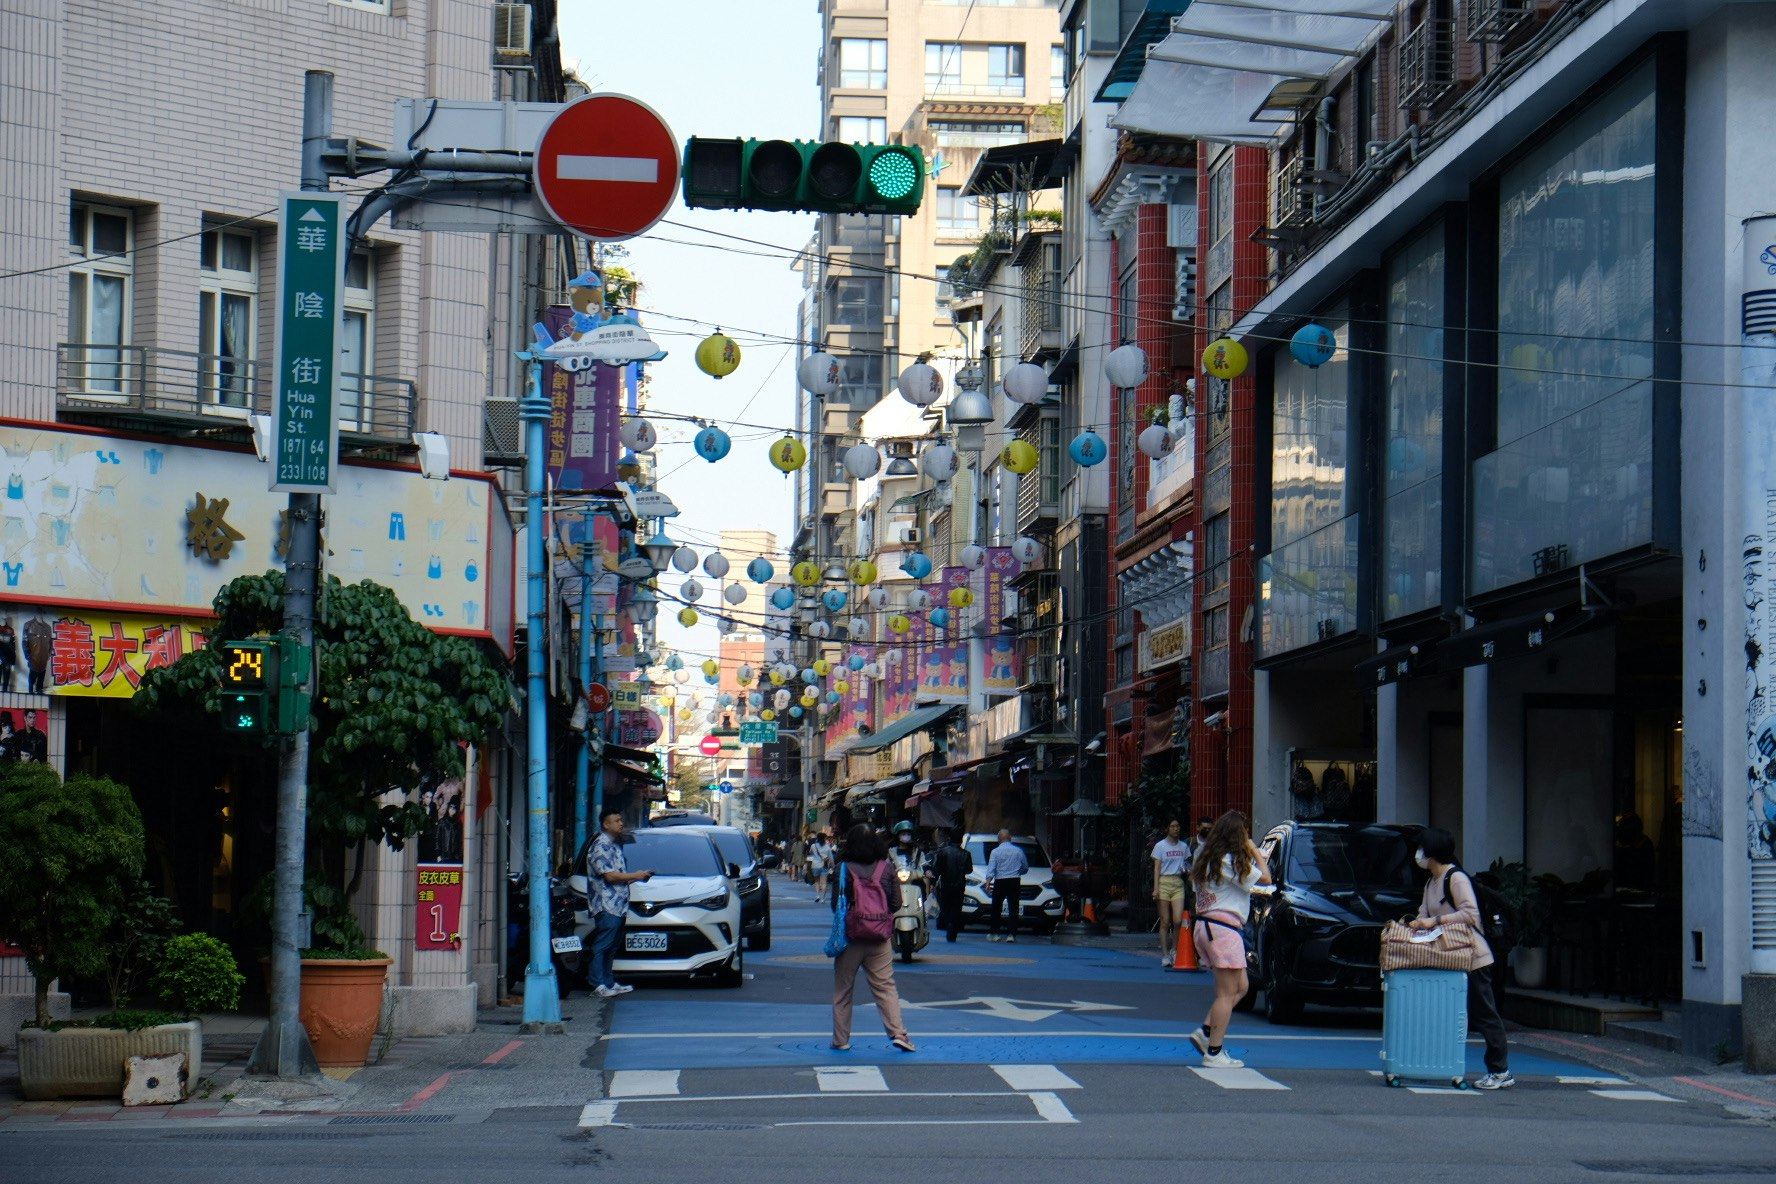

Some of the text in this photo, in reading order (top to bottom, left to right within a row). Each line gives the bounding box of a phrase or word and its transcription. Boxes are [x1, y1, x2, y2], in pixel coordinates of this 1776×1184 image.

[292, 226, 327, 385] 華陰街
[287, 389, 315, 404] Hua
[287, 404, 313, 419] Yin
[286, 420, 307, 434] St.
[283, 438, 301, 454] 187
[310, 439, 324, 455] 64
[281, 464, 300, 480] 233
[307, 465, 326, 481] 108
[52, 616, 211, 689] 義大利
[229, 648, 262, 681] 24
[429, 903, 447, 942] 1
